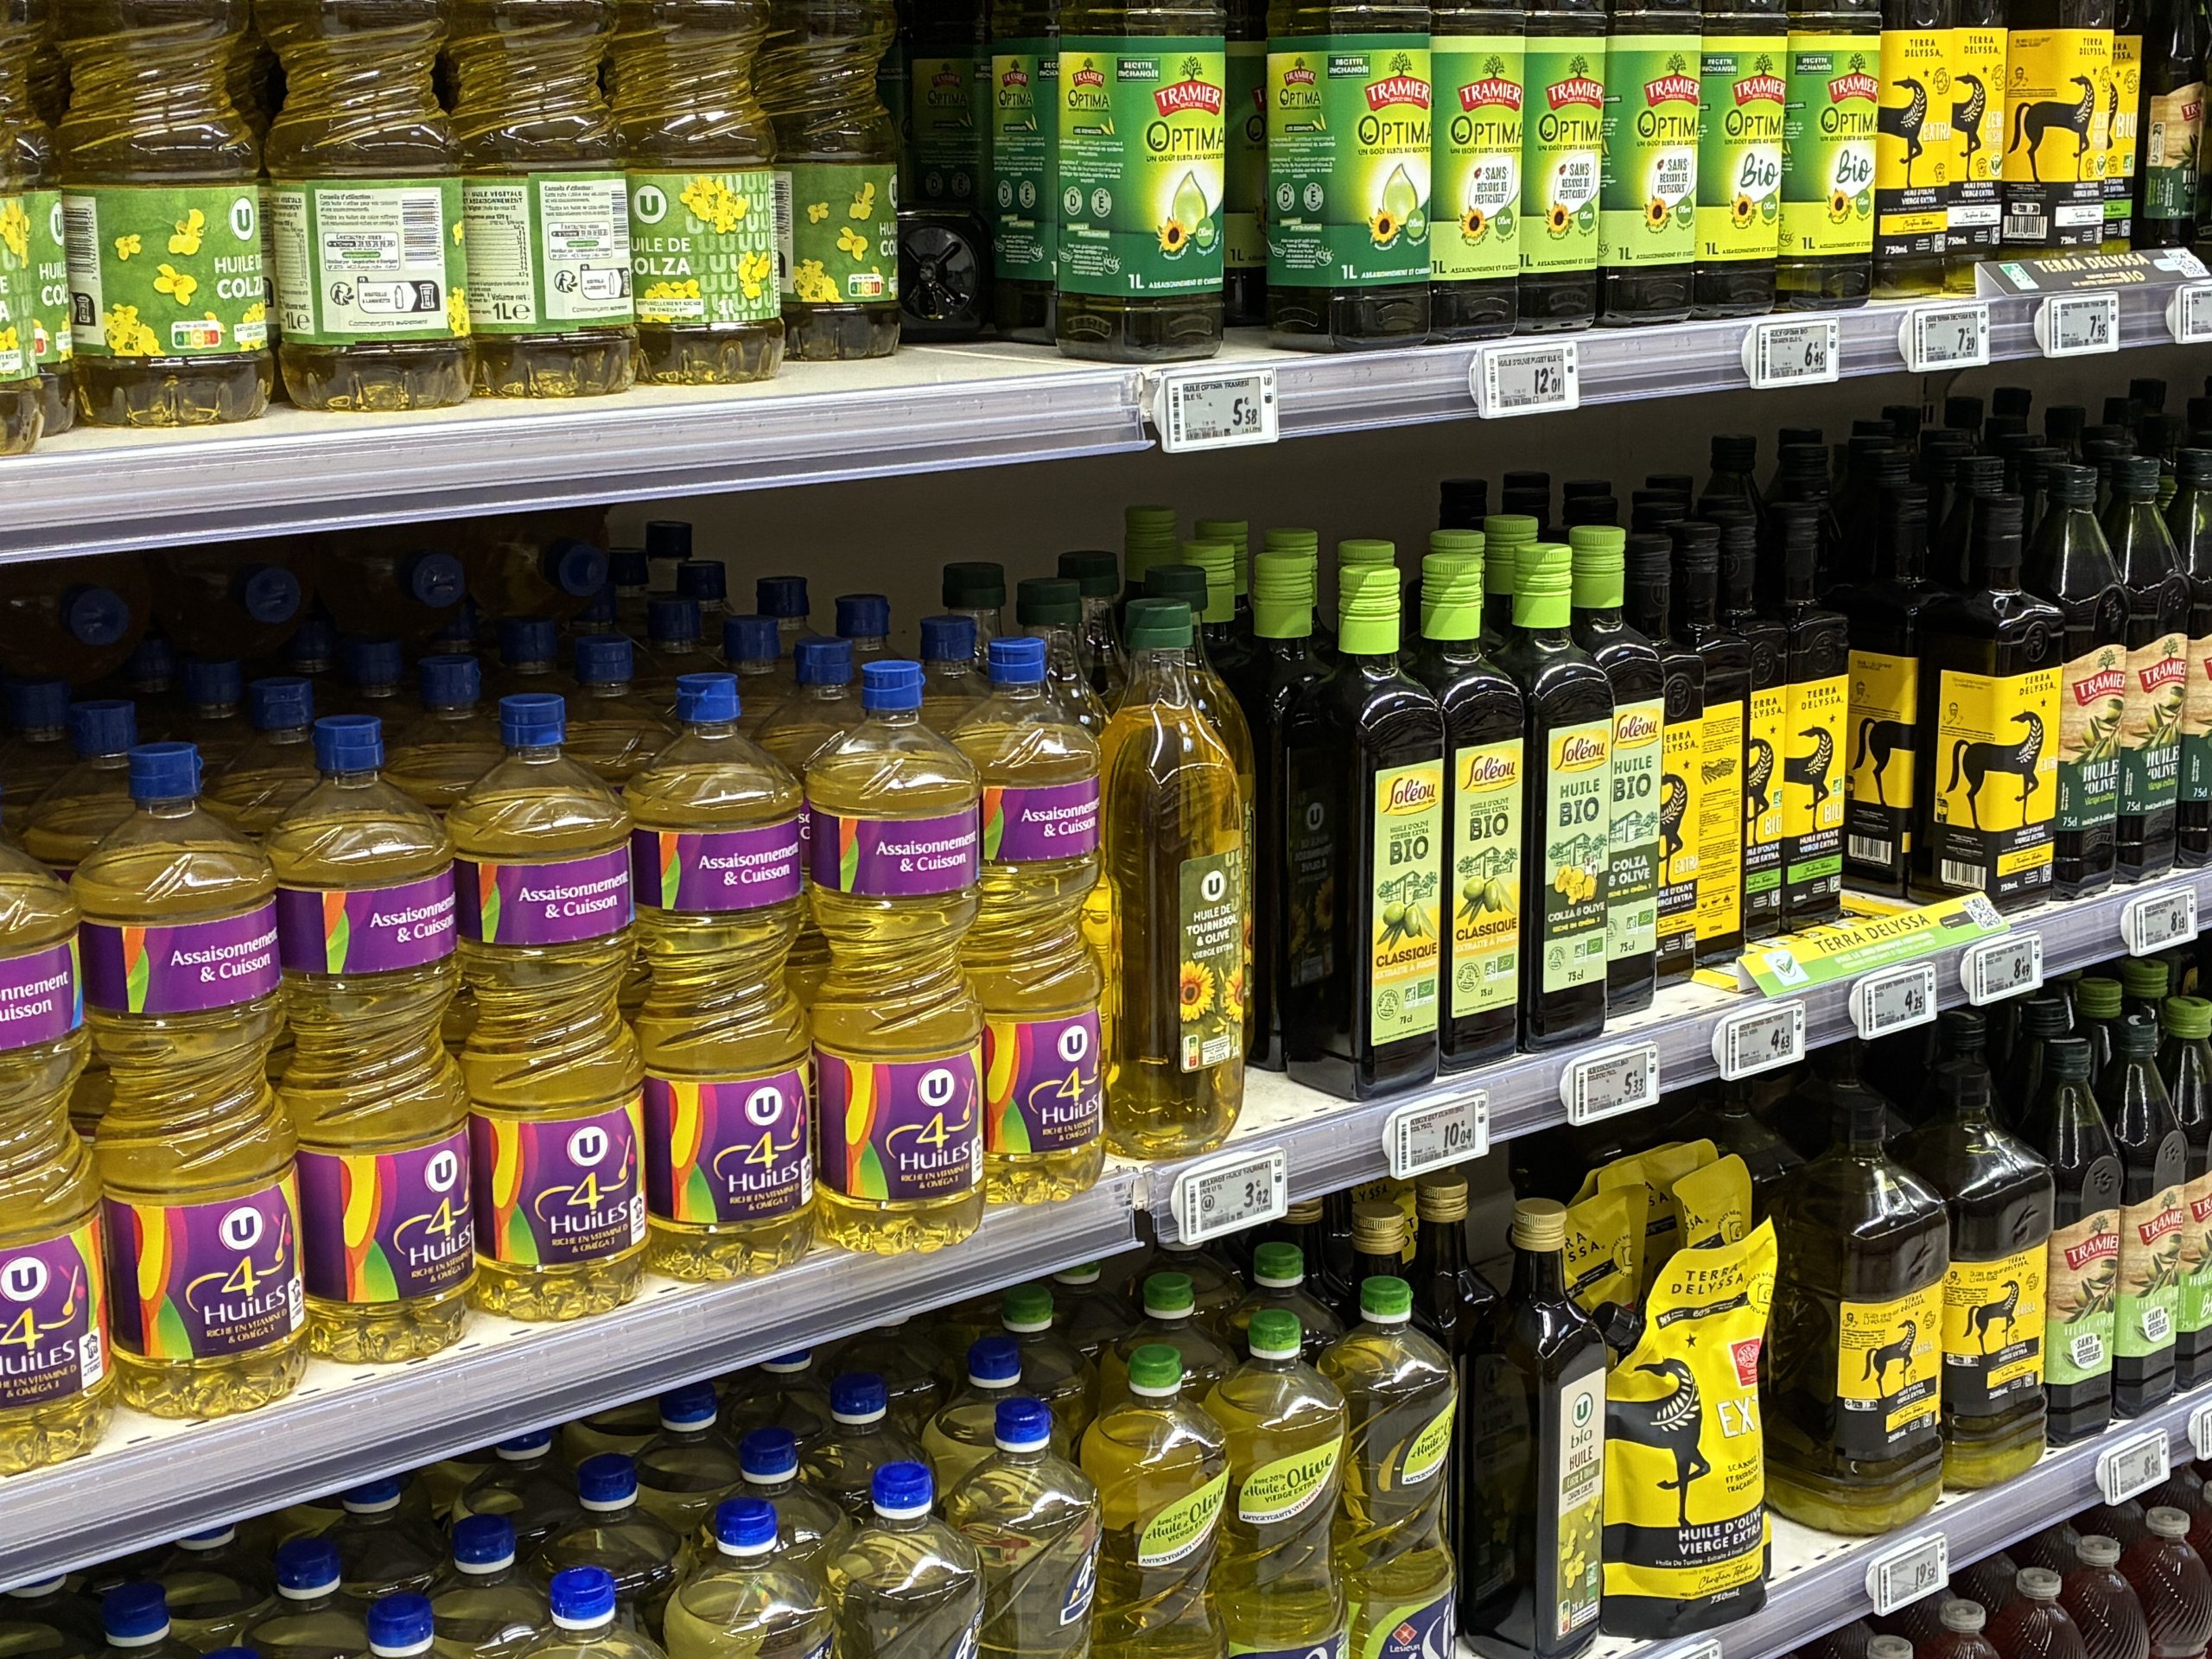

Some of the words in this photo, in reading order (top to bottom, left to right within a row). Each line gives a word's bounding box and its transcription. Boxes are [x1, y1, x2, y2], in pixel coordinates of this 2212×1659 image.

[1910, 39, 1936, 48] TERRA
[1964, 45, 1999, 54] DELYSSA
[1968, 36, 1994, 45] TERRA
[2083, 37, 2103, 47] TERRA
[1904, 48, 1941, 58] DELYSSA
[1072, 73, 1105, 86] TRAMIER
[1285, 72, 1316, 84] TRAMIER
[998, 89, 1033, 105] OPTIMA
[1068, 89, 1109, 106] OPTIMA
[1156, 85, 1223, 107] TRAMIER
[1280, 88, 1321, 105] OPTIMA
[1368, 81, 1430, 103] TRAMIER
[1460, 83, 1522, 105] TRAMIER
[1548, 83, 1604, 103] TRAMIER
[1648, 82, 1700, 100] TRAMIER
[1735, 82, 1785, 99] TRAMIER
[1829, 80, 1878, 97] TRAMIER
[1146, 120, 1224, 152] OPTIMA
[1484, 166, 1508, 181] SANS
[1568, 162, 1590, 176] SANS
[1668, 158, 1688, 173] SANS
[1739, 153, 1778, 188] Bio
[1835, 149, 1872, 184] Bio
[668, 238, 690, 252] DE
[1618, 247, 1632, 260] 1L
[1706, 242, 1719, 255] 1L
[1802, 237, 1815, 250] 1L
[214, 257, 251, 274] HUILE
[1431, 261, 1446, 274] 1L
[1519, 254, 1533, 267] 1L
[2034, 257, 2084, 273] TERRA
[2088, 252, 2152, 270] DELYSSA
[1128, 274, 1144, 289] 1L
[1341, 264, 1357, 279] 1L
[2119, 270, 2146, 283] BIO
[216, 276, 264, 300] COLZ
[493, 303, 512, 320] 1L
[2019, 682, 2055, 696] DELYSSA
[2024, 673, 2050, 685] TERRA
[1807, 686, 1837, 699] TERRA
[1801, 696, 1841, 711] DELYSSA
[1613, 713, 1657, 744] Soléou
[1555, 735, 1605, 771] Soléou
[2146, 746, 2179, 768] HUILE
[1463, 754, 1516, 791] Soléou
[1613, 755, 1652, 775] HUILE
[2083, 760, 2119, 782] HUILE
[1382, 777, 1436, 813] Soléou
[1560, 778, 1600, 798] HUILE
[1613, 773, 1652, 803] BIO
[1559, 798, 1599, 827] BIO
[1824, 803, 1840, 823] BIO
[1044, 823, 1056, 837] &
[1058, 816, 1096, 836] Cuisson
[1469, 812, 1509, 842] BIO
[1764, 816, 1782, 836] BIO
[875, 830, 976, 856] Assaisonnement
[1389, 836, 1429, 866] BIO
[899, 857, 914, 873] &
[917, 850, 967, 870] Cuisson
[1612, 855, 1649, 873] COLZA
[723, 871, 738, 886] &
[741, 862, 790, 884] Cuisson
[1618, 868, 1650, 886] OLIVE
[519, 871, 629, 902] Assaisonnement
[545, 904, 560, 918] &
[563, 893, 618, 916] Cuisson
[1193, 907, 1220, 923] HUILE
[1220, 904, 1231, 916] DE
[1548, 908, 1576, 922] COLZA
[1583, 902, 1605, 917] OLIVE
[397, 927, 411, 943] &
[414, 913, 454, 939] Cuisson
[1186, 916, 1238, 937] TOURNESOL
[1205, 928, 1230, 945] OLIVE
[1456, 917, 1517, 942] CLASSIQUE
[1814, 933, 1864, 954] TERRA
[1866, 913, 1931, 940] DELYSSA
[1376, 942, 1437, 968] CLASSIQUE
[200, 966, 216, 982] &
[219, 953, 271, 979] Cuisson
[0, 998, 53, 1022] uisson
[1056, 1067, 1084, 1103] 4
[917, 1112, 951, 1149] 4
[745, 1131, 779, 1170] 4
[567, 1172, 604, 1210] 4
[425, 1198, 456, 1236] 4
[2069, 1236, 2119, 1264] TRAMIE
[221, 1255, 261, 1296] 4
[1686, 1263, 1739, 1282] TERRA
[1671, 1273, 1745, 1295] DELYSSA
[207, 1326, 232, 1339] RICHE
[234, 1324, 248, 1334] EN
[248, 1311, 280, 1331] VITAMINE
[2147, 1307, 2162, 1323] SANS
[0, 1307, 44, 1351] 4
[2076, 1335, 2094, 1350] SANS
[1571, 1428, 1592, 1449] bio
[1569, 1445, 1593, 1471] HUILE
[1264, 1491, 1293, 1503] VIERGE
[1678, 1523, 1720, 1541] HUILE
[1678, 1535, 1729, 1555] VIERGE
[1733, 1522, 1761, 1545] EXTRA
